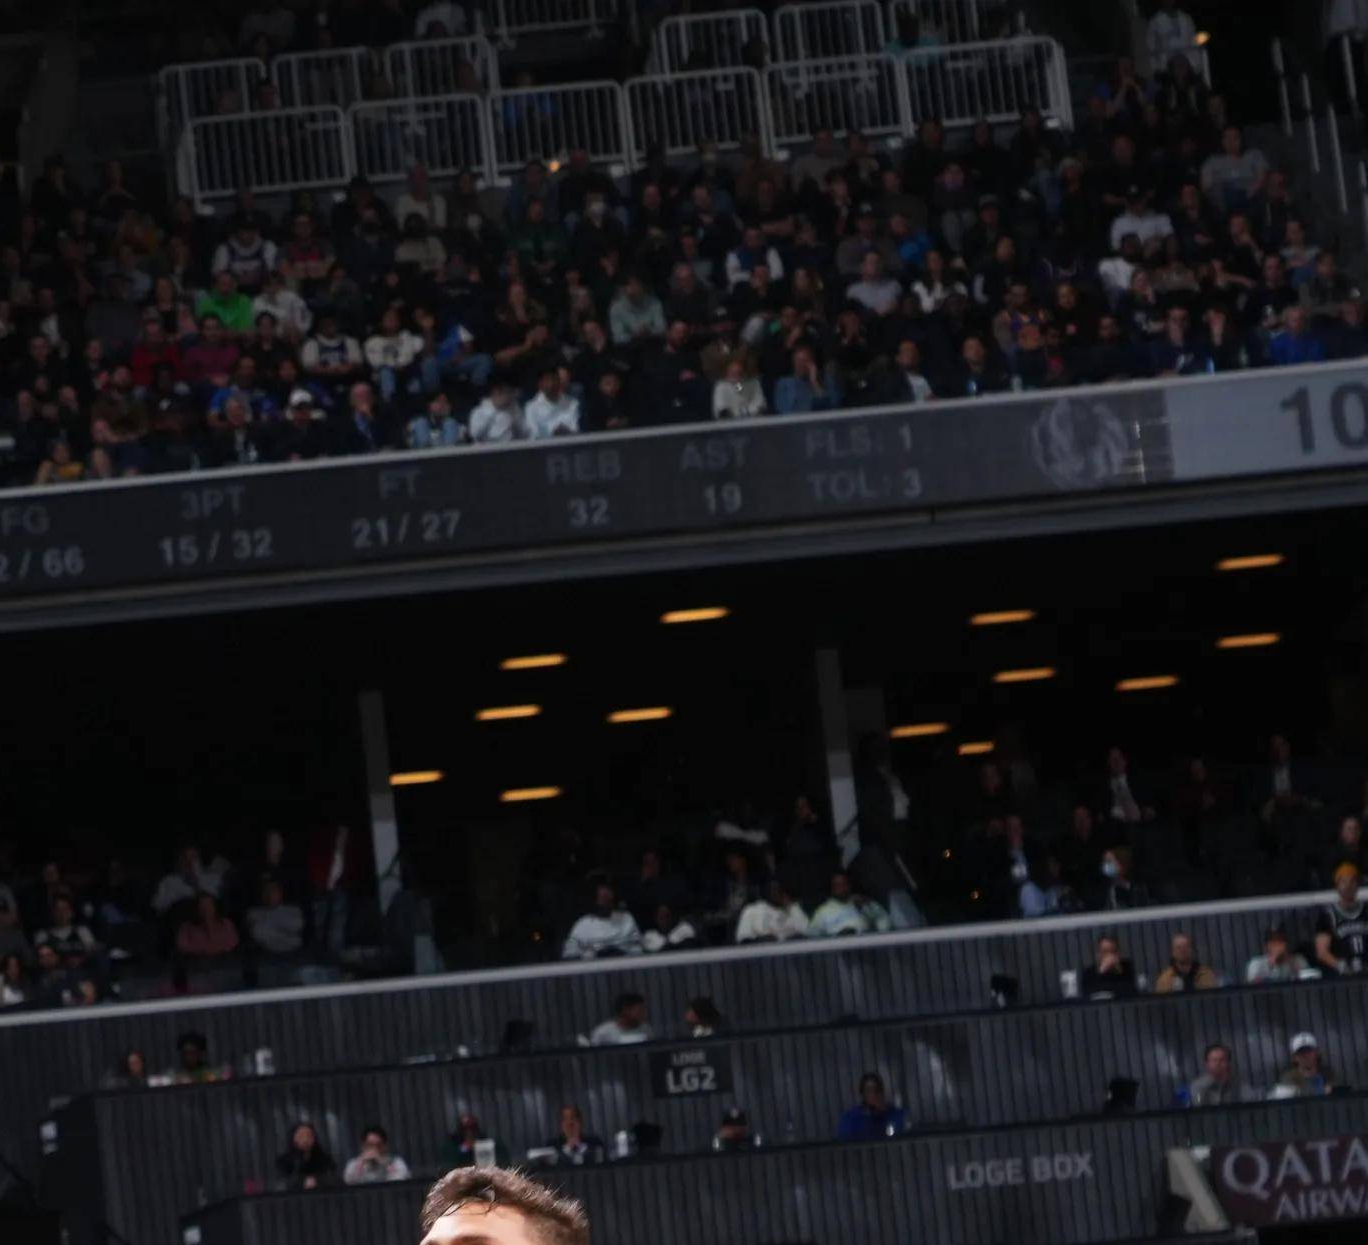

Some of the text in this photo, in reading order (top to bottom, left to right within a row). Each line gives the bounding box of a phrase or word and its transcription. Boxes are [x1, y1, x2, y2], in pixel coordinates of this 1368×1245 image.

[546, 448, 623, 484] REB
[679, 435, 749, 472] AST
[378, 467, 422, 501] FT
[900, 467, 923, 498] 3
[179, 484, 246, 520] 3PT
[568, 497, 610, 527] 32
[703, 484, 743, 516] 19
[0, 503, 51, 537] FG
[352, 516, 389, 549] 21
[422, 509, 462, 542] 27
[43, 545, 85, 579] 66
[160, 532, 199, 568] 15
[232, 526, 273, 560] 32
[666, 1066, 717, 1094] LG2
[946, 1153, 1094, 1190] LOGE BOX
